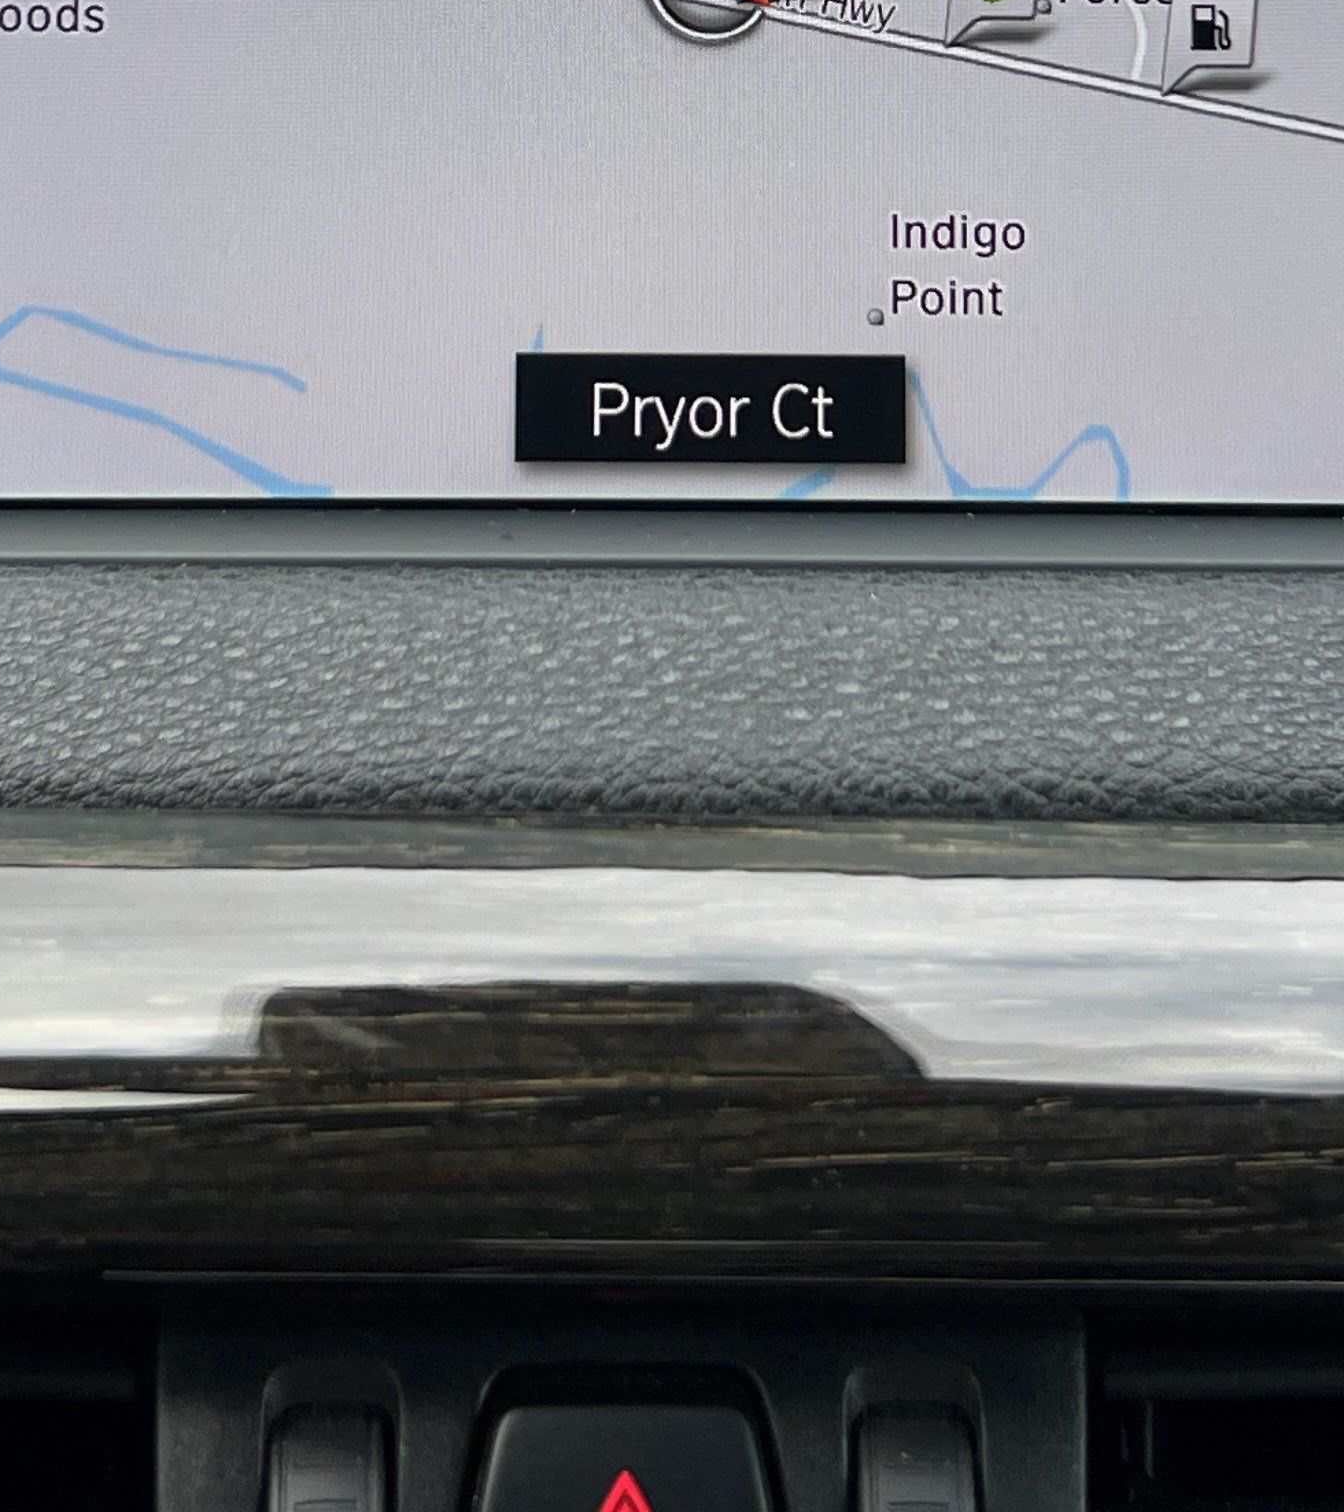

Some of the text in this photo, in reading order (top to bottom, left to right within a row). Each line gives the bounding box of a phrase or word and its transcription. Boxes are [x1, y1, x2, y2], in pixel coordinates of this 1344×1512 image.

[890, 213, 1027, 258] Indigo
[890, 278, 1004, 318] Point
[592, 381, 835, 451] Pryor Ct
